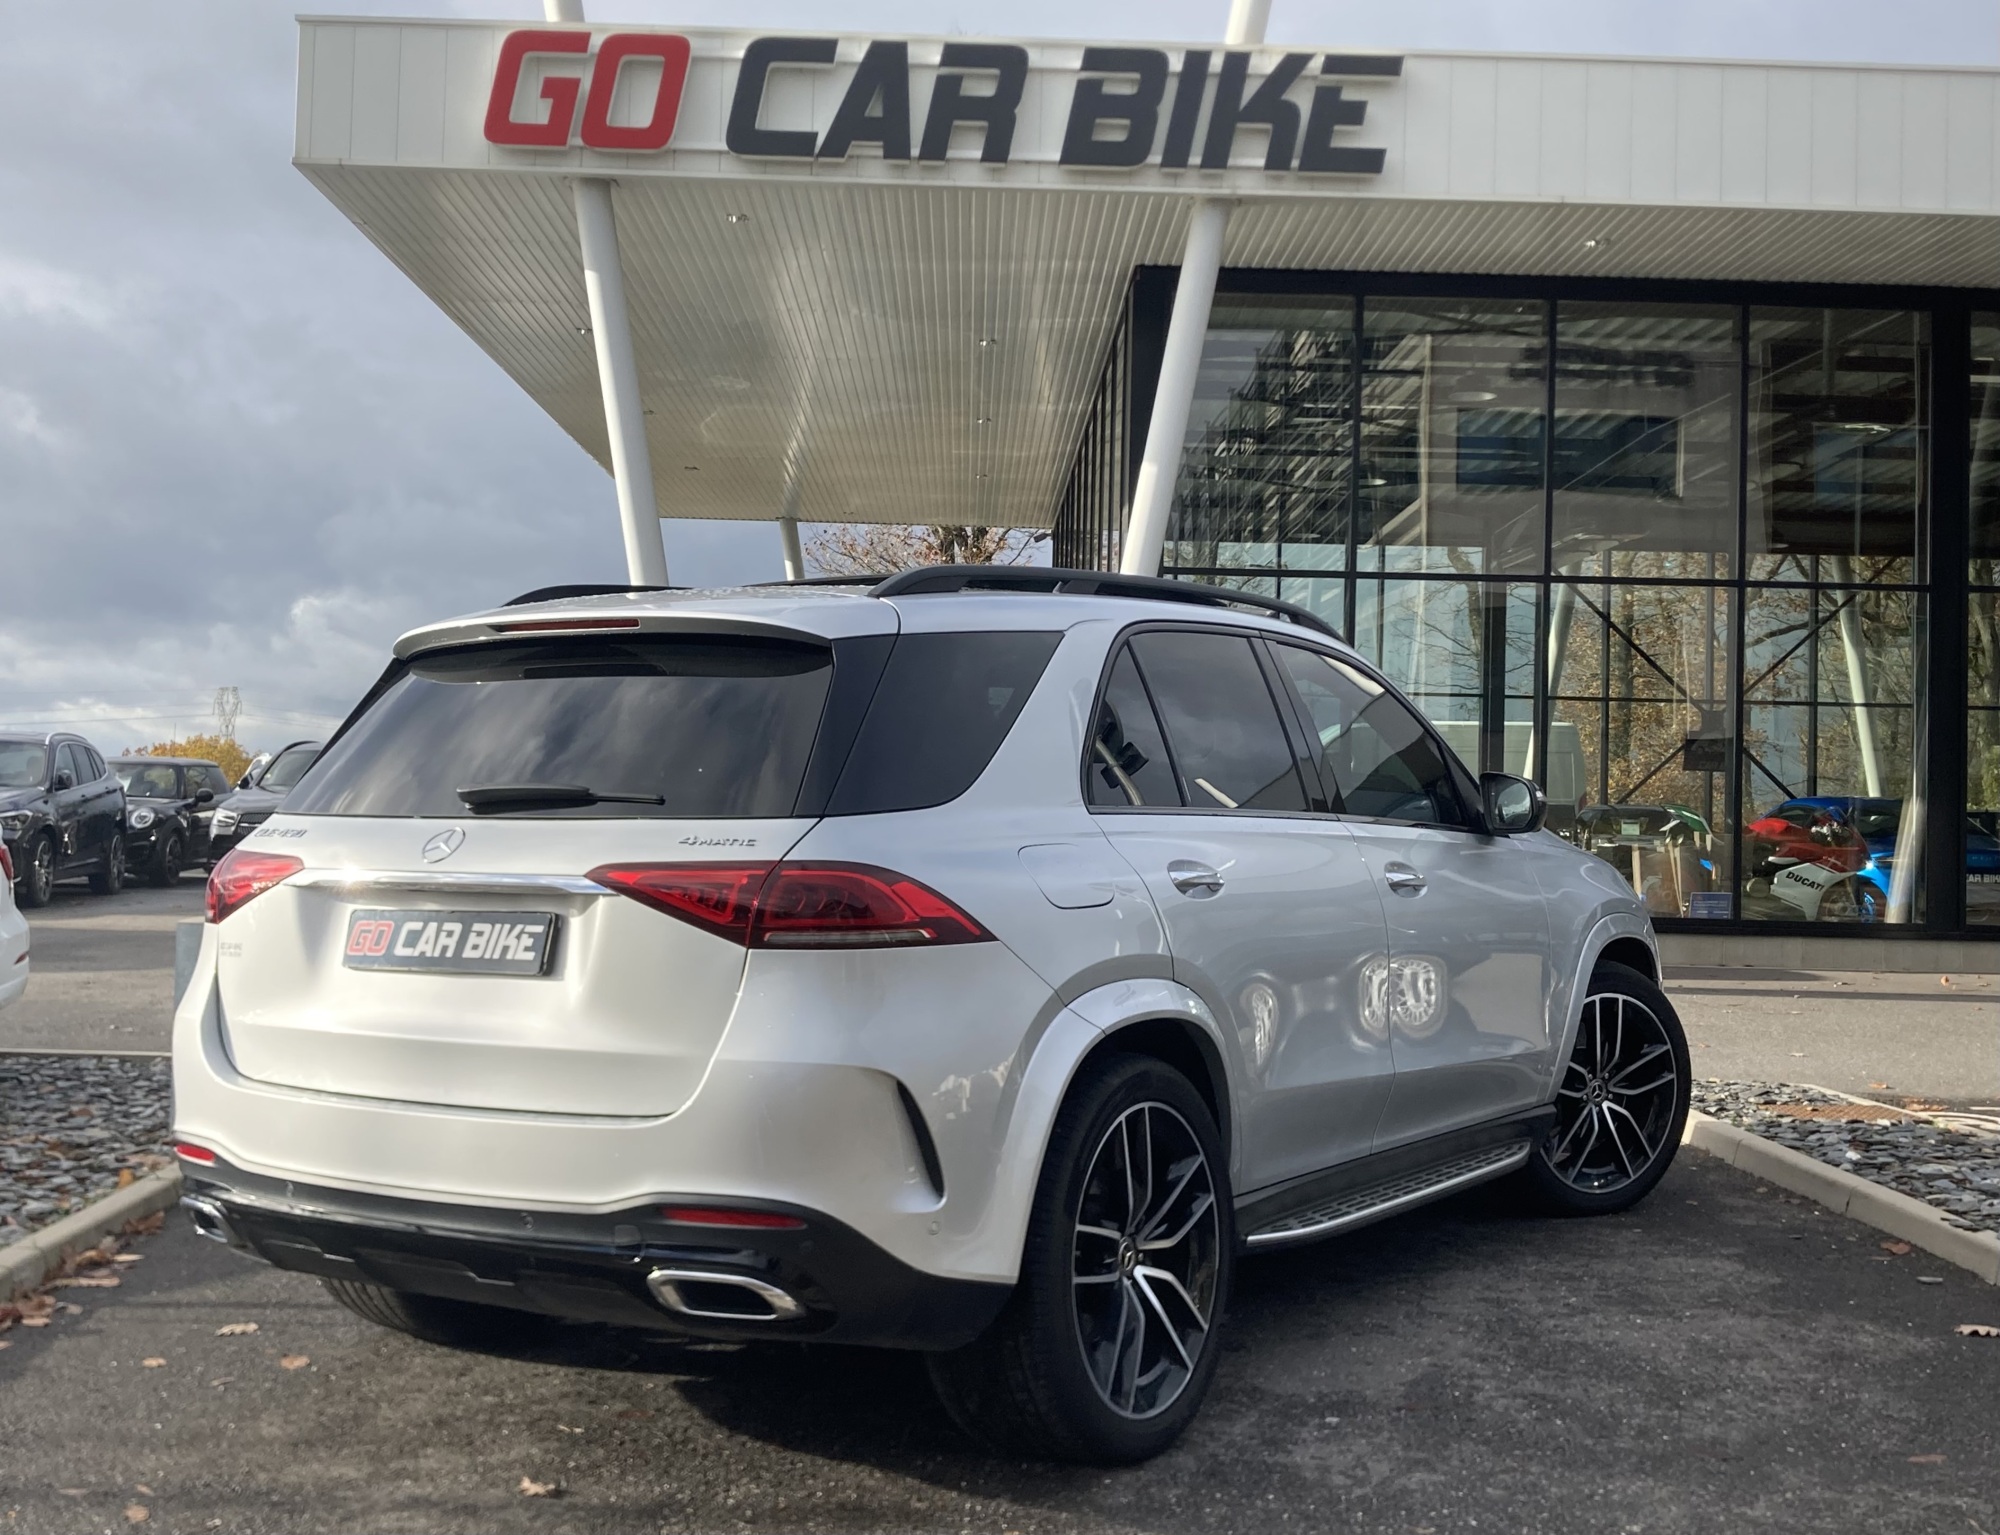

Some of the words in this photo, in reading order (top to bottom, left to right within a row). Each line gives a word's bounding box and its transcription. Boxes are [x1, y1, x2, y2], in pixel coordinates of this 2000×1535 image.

[484, 30, 691, 150] GO
[726, 37, 1029, 163] CAR
[1058, 47, 1405, 173] BIKE
[678, 836, 757, 847] 4MATIC
[1785, 871, 1825, 892] DUCATI
[347, 920, 395, 956] GO
[393, 921, 463, 958] CAR
[462, 922, 545, 960] BIKE
